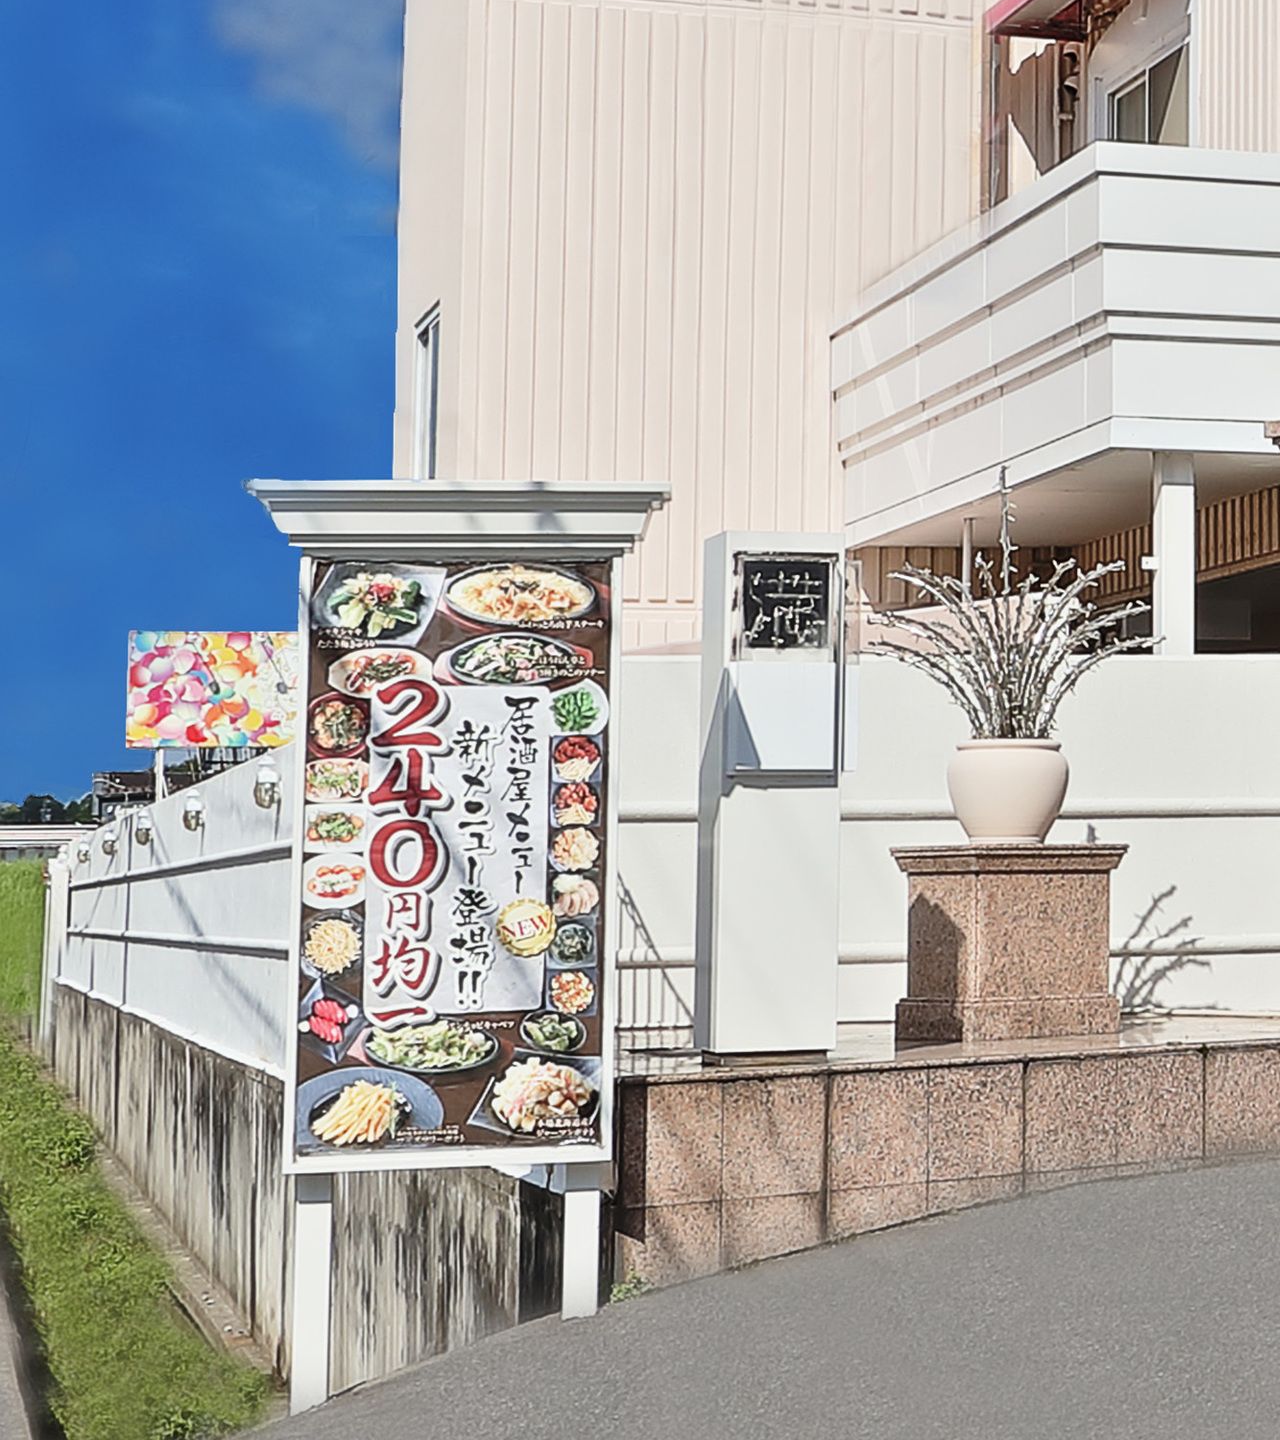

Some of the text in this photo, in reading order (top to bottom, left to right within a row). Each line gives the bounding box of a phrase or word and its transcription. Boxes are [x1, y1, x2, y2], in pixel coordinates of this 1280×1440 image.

[499, 695, 540, 896] 居酒屋メニュー
[500, 915, 554, 942] NEW
